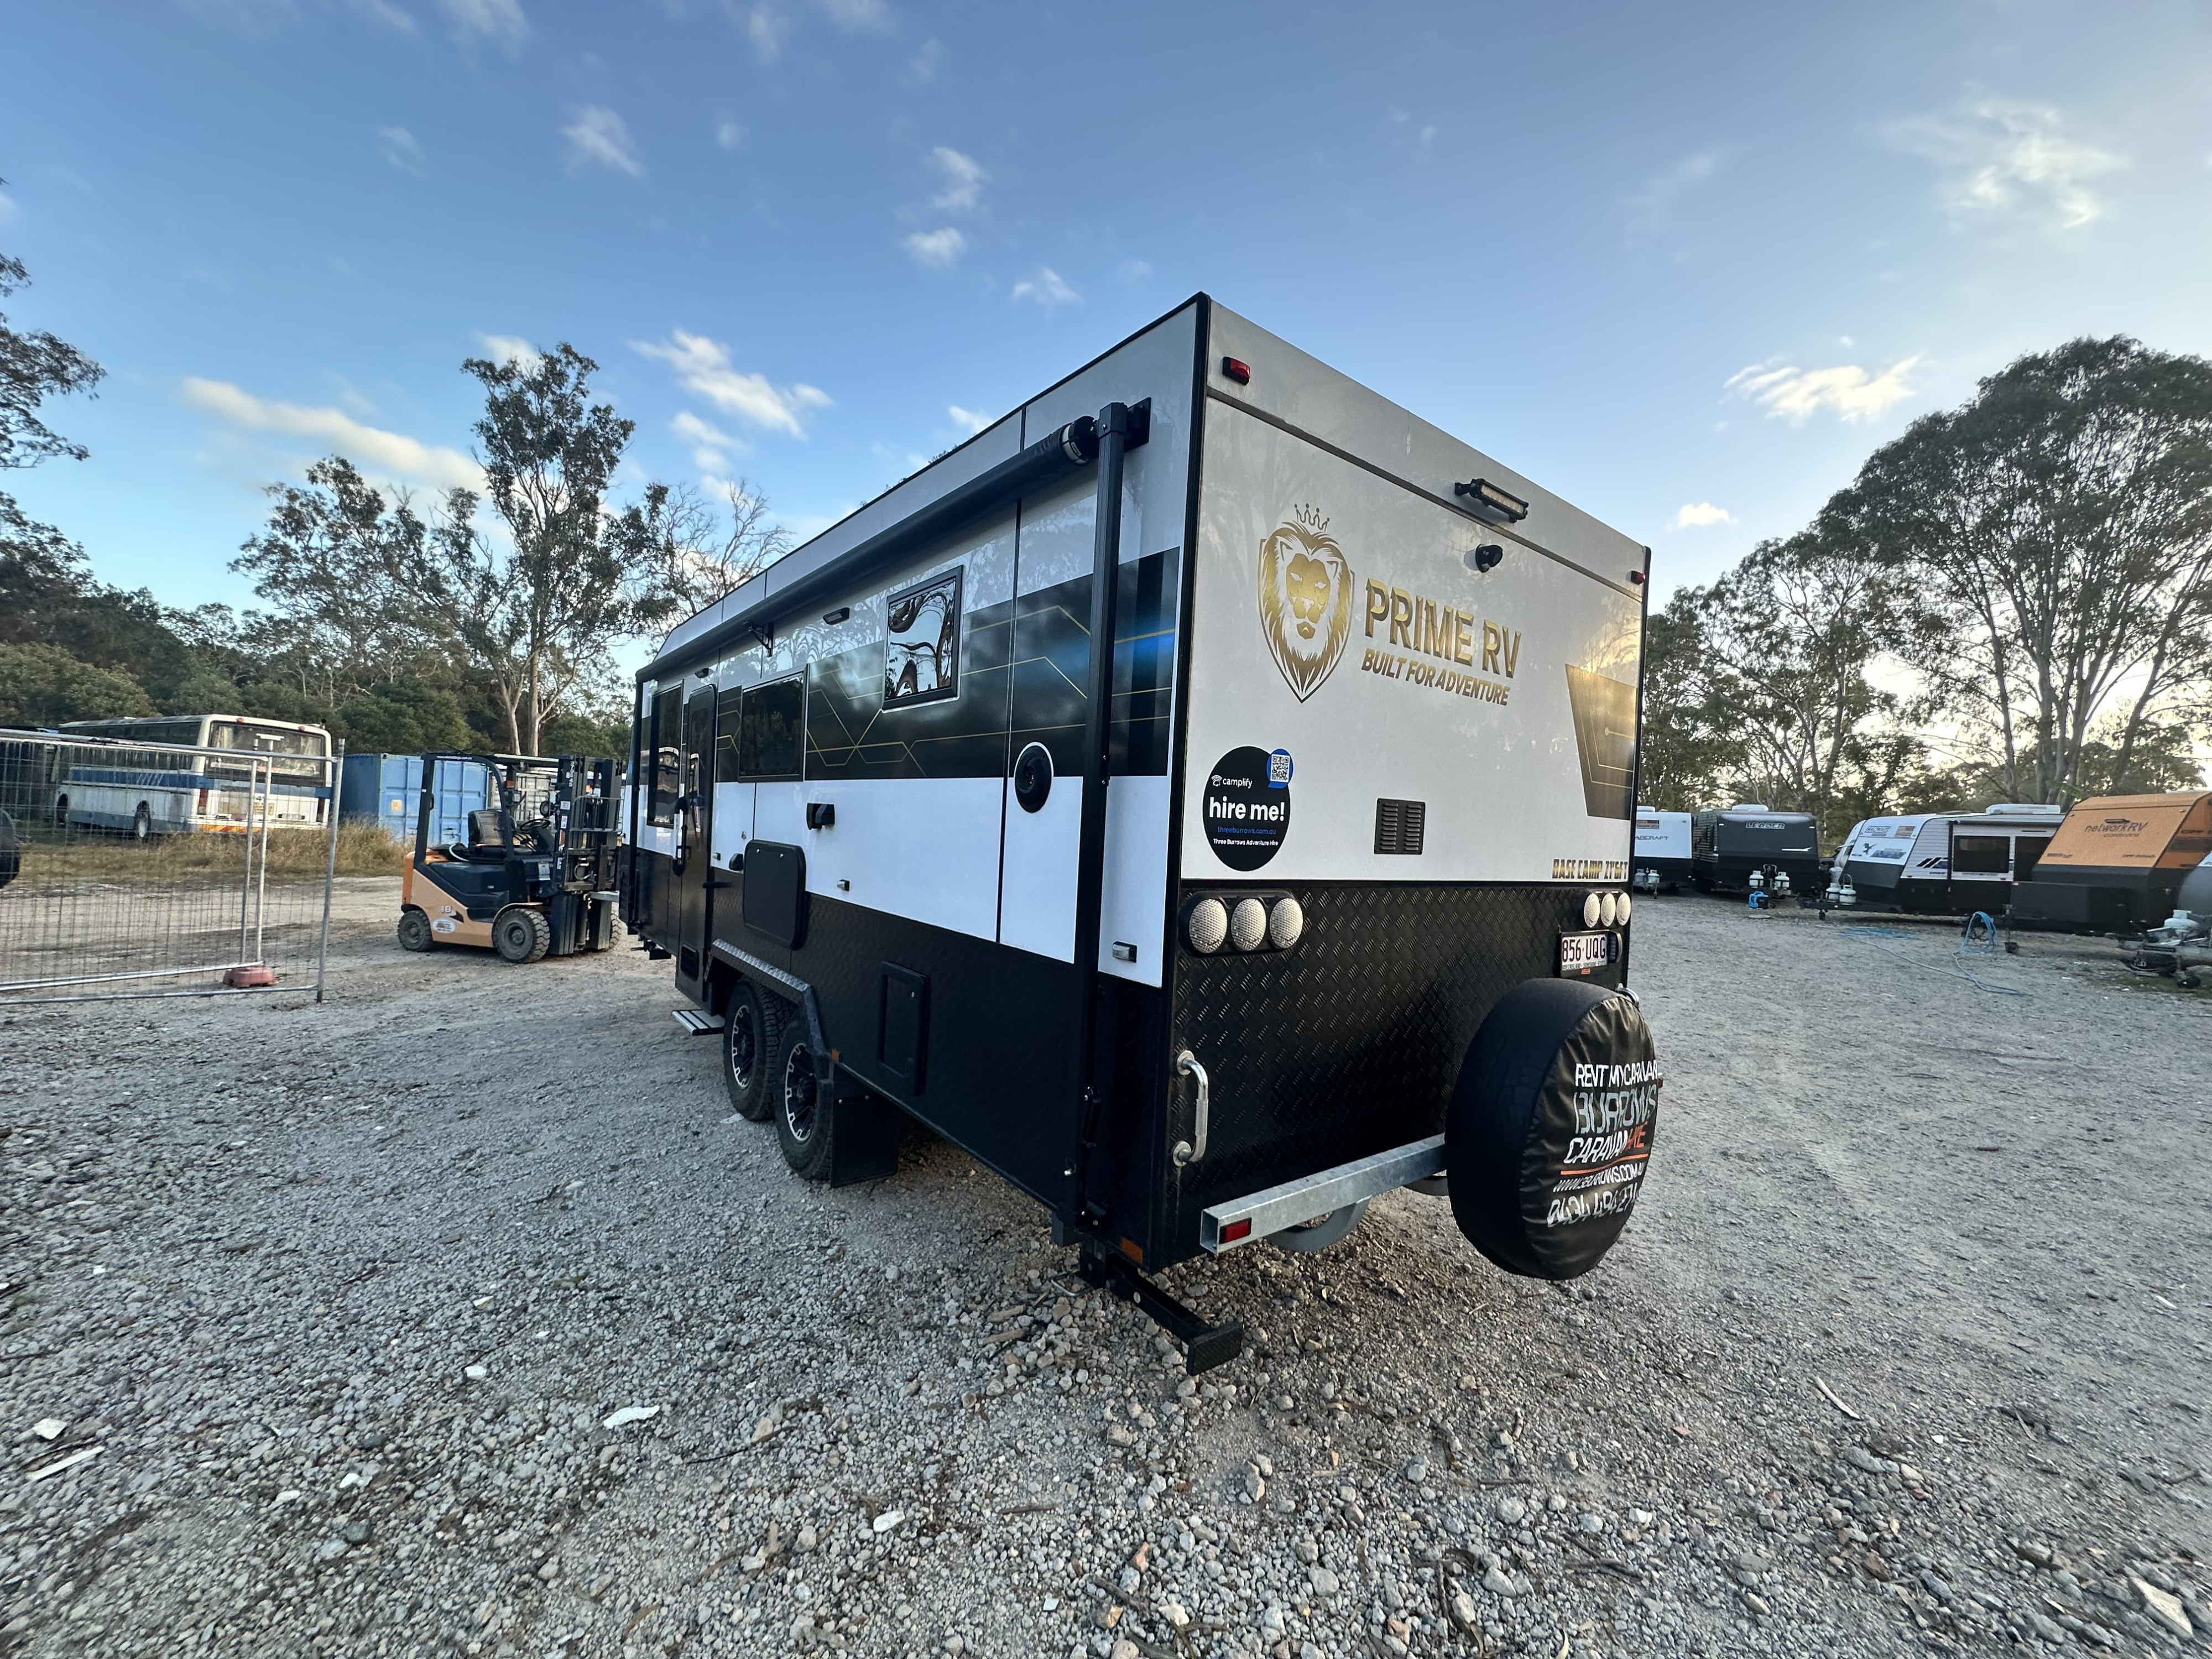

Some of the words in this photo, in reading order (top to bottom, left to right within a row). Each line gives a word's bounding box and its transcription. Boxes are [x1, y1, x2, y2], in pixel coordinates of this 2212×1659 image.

[1365, 577, 1474, 667] PRIME
[1482, 619, 1521, 679] RV
[1361, 648, 1407, 679] BUILT
[1405, 660, 1436, 687] FOR
[1434, 668, 1511, 706] ADVENTURE
[1222, 778, 1253, 789] camplify
[1209, 796, 1246, 820] hire
[1250, 801, 1285, 821] me!
[1217, 826, 1276, 835] threeburrows.com.au
[1552, 859, 1576, 879] BASE
[1577, 860, 1603, 879] CAMP
[1562, 939, 1581, 962] 856
[1586, 937, 1605, 960] UQG
[1575, 1063, 1609, 1087] RENT
